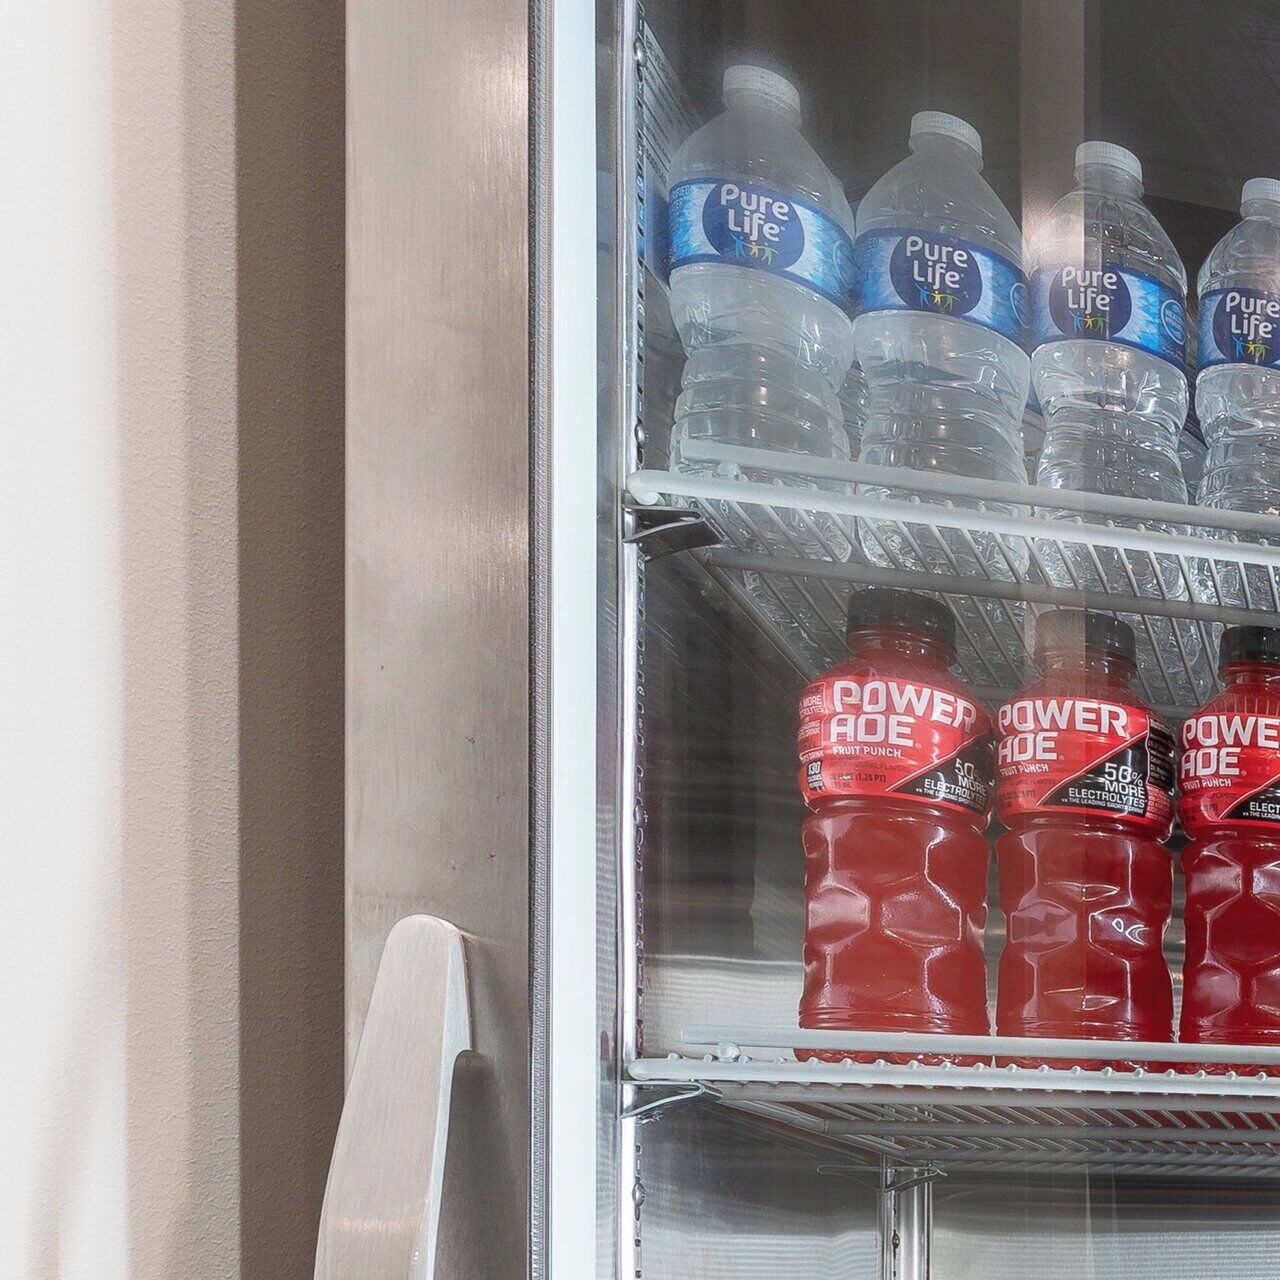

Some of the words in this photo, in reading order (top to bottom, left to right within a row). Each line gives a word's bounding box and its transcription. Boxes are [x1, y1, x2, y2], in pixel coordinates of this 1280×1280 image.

[720, 183, 790, 221] Pure
[728, 209, 780, 242] Life
[906, 235, 968, 268] Pure
[913, 260, 960, 290] Life
[1062, 266, 1118, 290] Pure
[1067, 288, 1110, 314] Life
[1225, 292, 1280, 318] Pure
[1231, 313, 1273, 339] Life
[833, 681, 977, 733] POWER
[999, 700, 1129, 740] POWER
[830, 714, 917, 747] ADE
[833, 745, 860, 755] FRUIT
[863, 747, 901, 757] PUNCH
[1104, 763, 1143, 786] 50%
[1069, 788, 1145, 808] ELECTROLYTES
[1105, 781, 1145, 798] MORE
